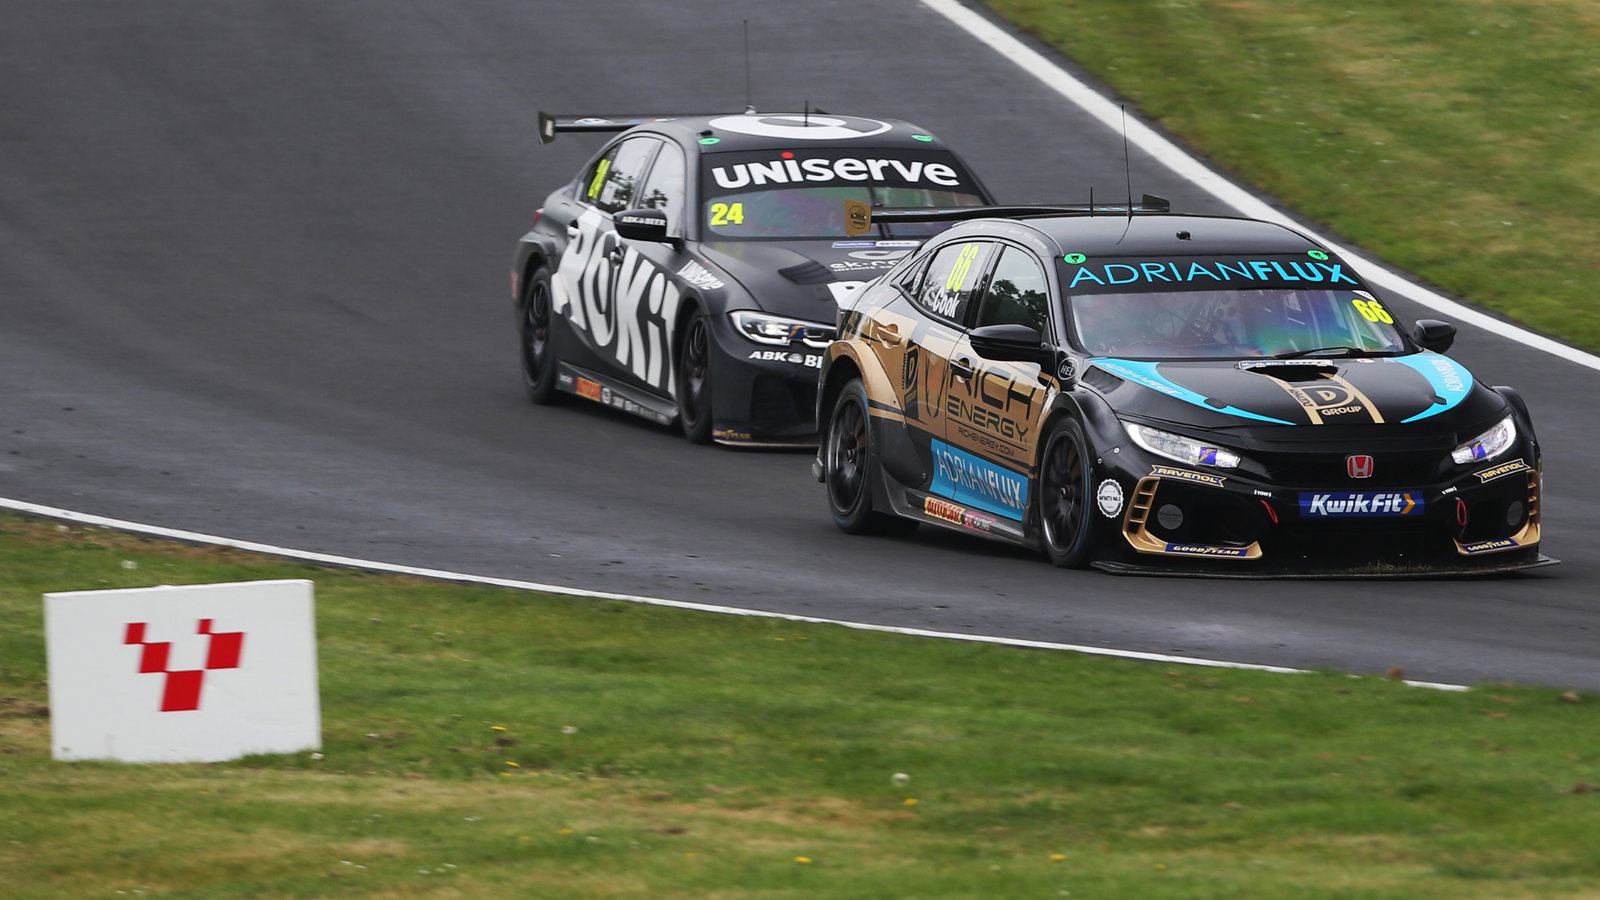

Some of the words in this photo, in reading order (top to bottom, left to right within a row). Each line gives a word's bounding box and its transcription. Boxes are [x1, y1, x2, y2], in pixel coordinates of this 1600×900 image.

[710, 202, 745, 226] 24
[946, 242, 979, 293] 66
[1069, 260, 1359, 288] ADRIANFLUX
[932, 286, 960, 318] Cook
[1352, 299, 1394, 324] 66
[748, 351, 789, 361] ABK
[949, 352, 1037, 421] RICH
[947, 394, 1029, 443] ENERGY
[1321, 405, 1362, 416] GROUP
[936, 448, 1027, 509] ADRIANFLUX
[1158, 468, 1217, 483] RAVENOL
[1481, 462, 1524, 479] RAVENOL
[1173, 545, 1240, 555] GOODYEAR
